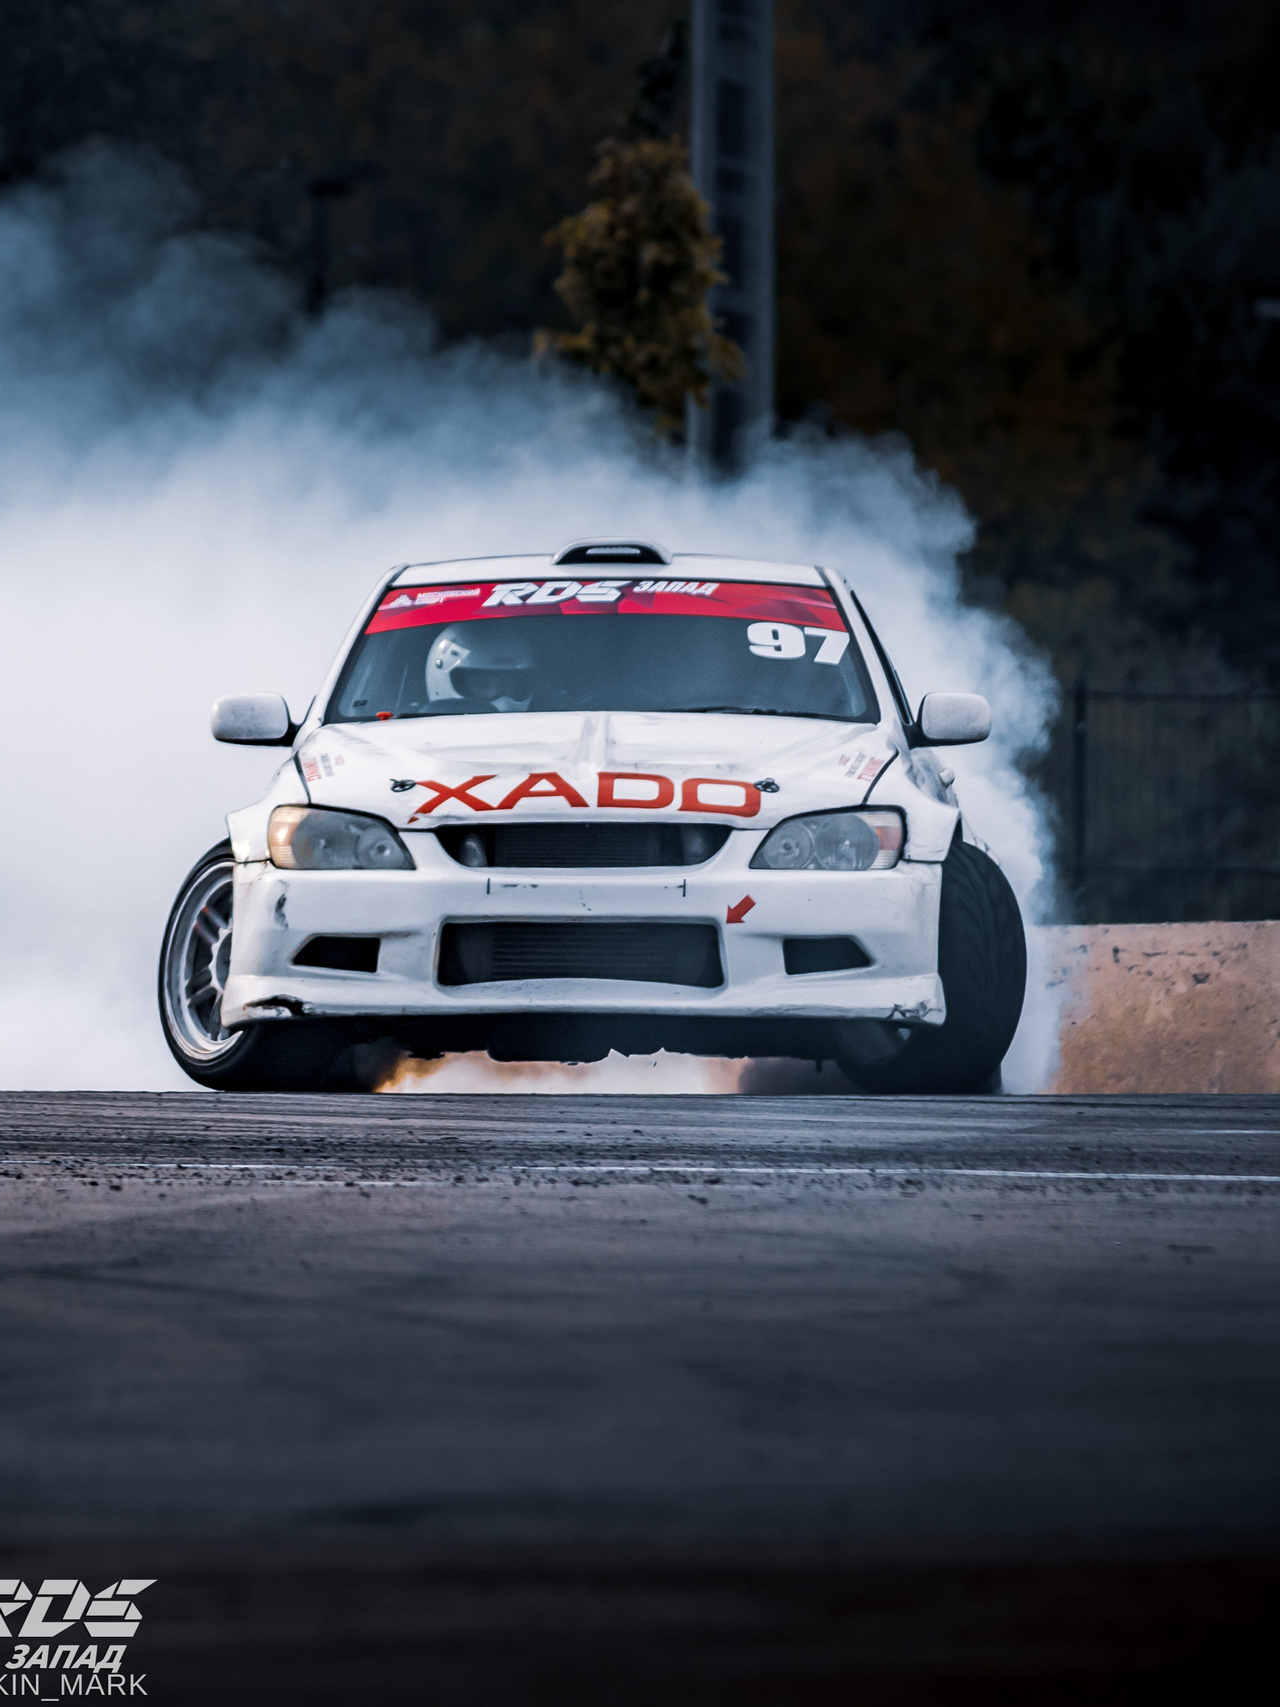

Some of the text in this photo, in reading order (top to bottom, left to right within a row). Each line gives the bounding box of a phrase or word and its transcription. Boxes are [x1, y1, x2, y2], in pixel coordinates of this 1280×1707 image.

[481, 581, 632, 607] RDS
[632, 580, 720, 596] ЗАПАД
[746, 621, 850, 666] 97
[407, 771, 762, 825] XADO
